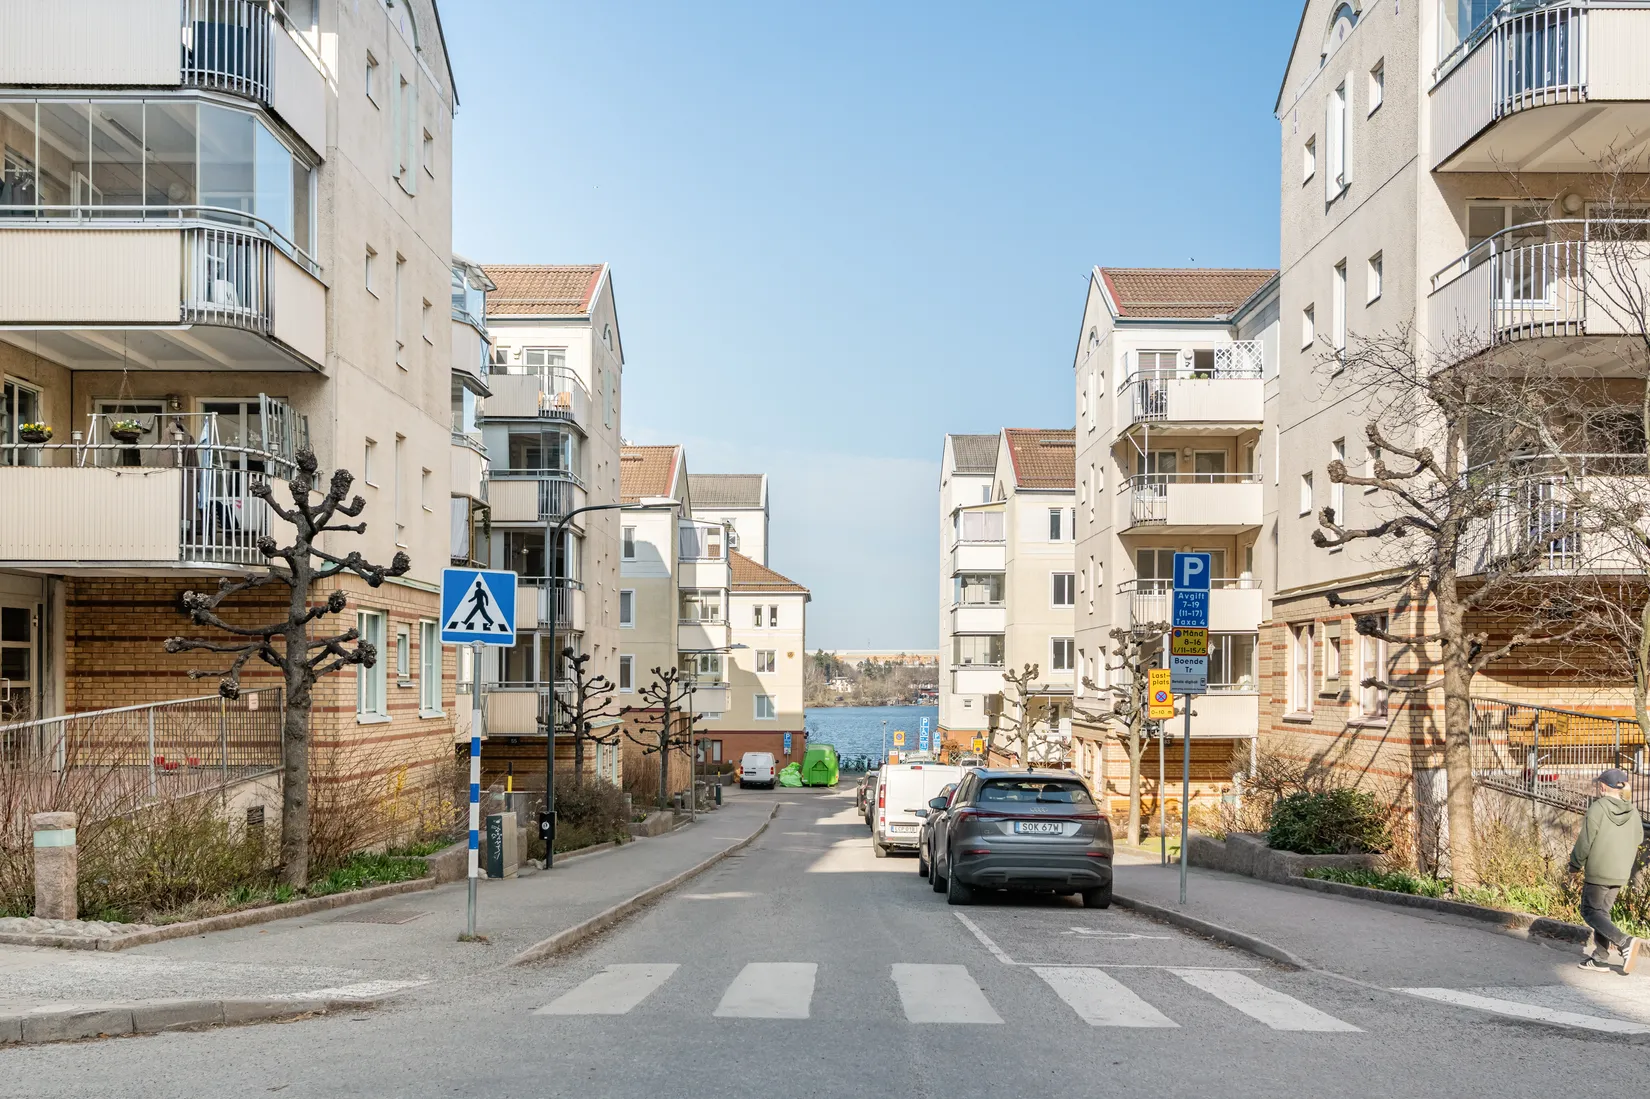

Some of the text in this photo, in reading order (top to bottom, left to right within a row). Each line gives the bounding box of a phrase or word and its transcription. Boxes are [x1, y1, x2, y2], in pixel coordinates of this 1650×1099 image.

[1183, 556, 1204, 586] P
[1178, 592, 1205, 600] Avgift
[1178, 609, 1202, 618] (11-17)
[922, 718, 928, 726] P
[1022, 823, 1060, 832] SOK 67W
